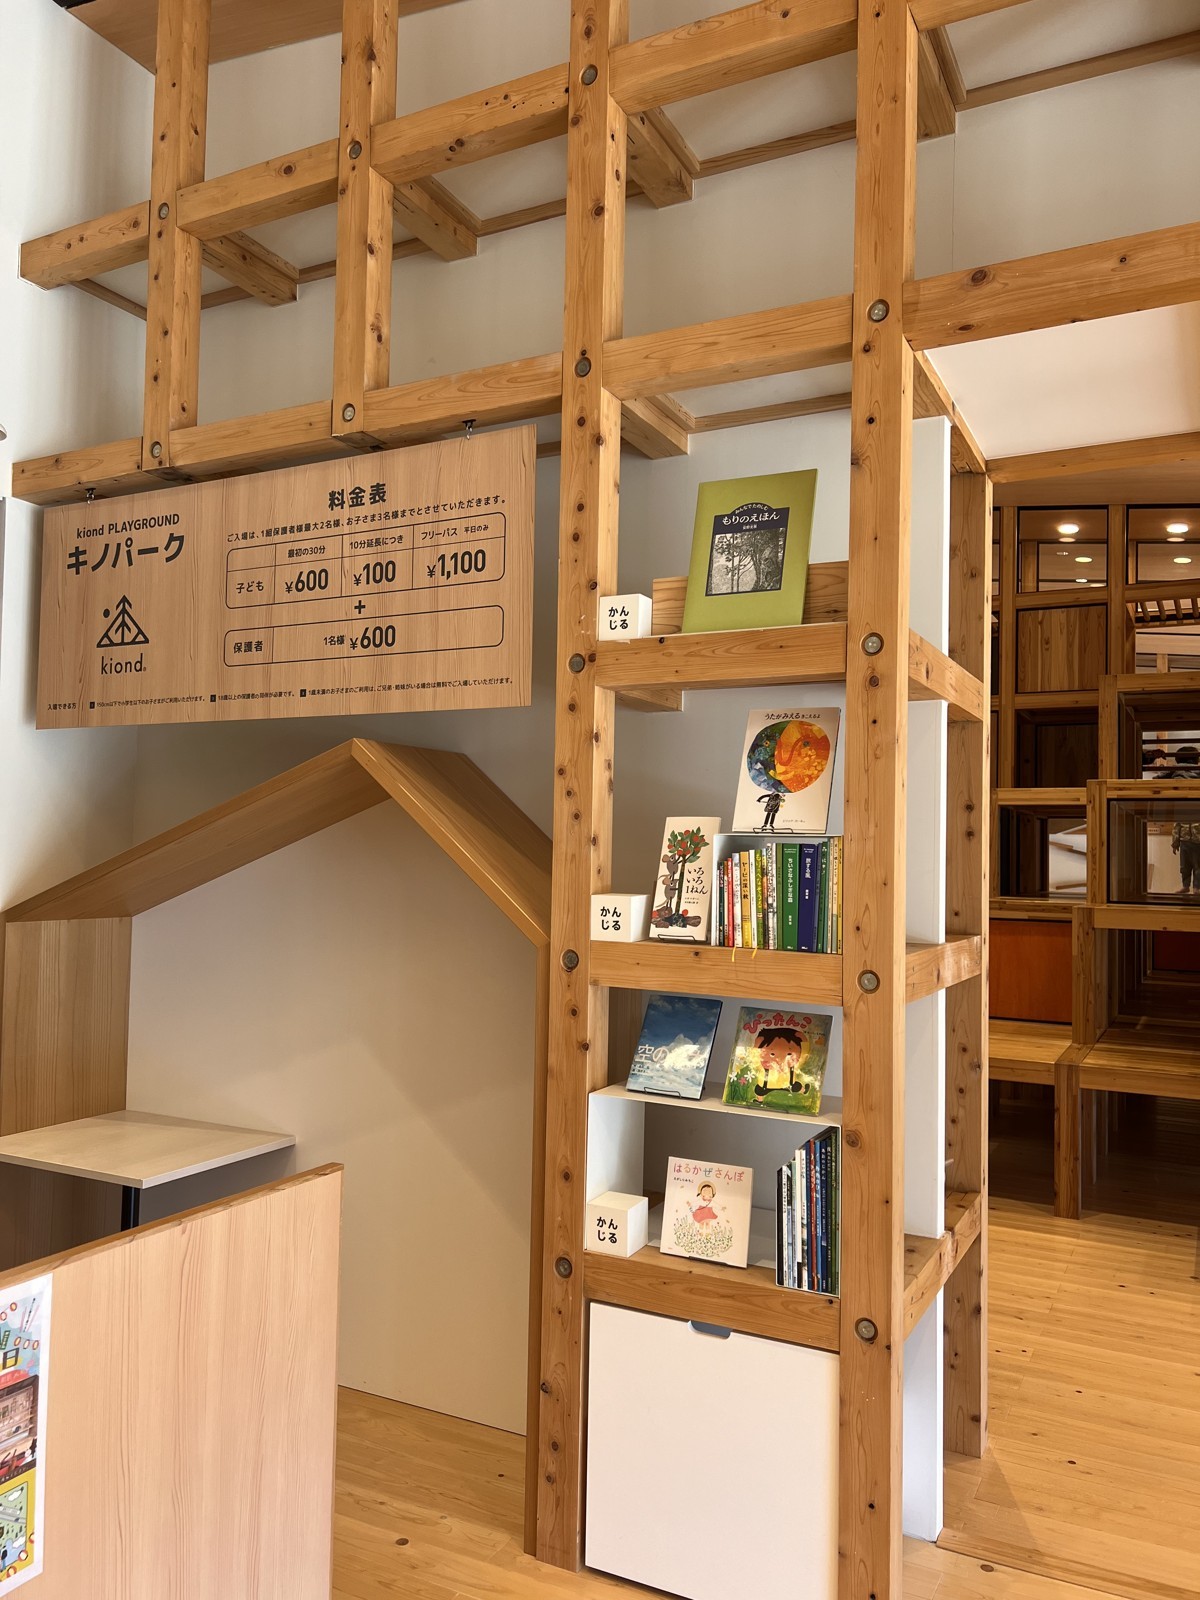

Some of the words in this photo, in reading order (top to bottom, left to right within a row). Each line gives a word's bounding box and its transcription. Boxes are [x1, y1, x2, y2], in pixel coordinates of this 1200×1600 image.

[328, 483, 386, 511] 料金表
[722, 511, 781, 525] もりのえほん
[76, 524, 104, 539] kiond
[108, 513, 180, 534] PLAYGROUND
[421, 527, 458, 541] フリーパス
[464, 524, 489, 534] 平日のみ
[350, 534, 404, 549] 10分延長につき
[67, 533, 185, 575] キノパーク
[288, 545, 326, 558] 最初の30分
[427, 549, 486, 580] ¥1,100
[353, 560, 396, 586] ¥100
[236, 580, 264, 594] 子ども
[285, 568, 329, 594] ¥600
[608, 606, 630, 618] かん
[609, 618, 629, 631] じる
[323, 635, 346, 646] 1名様
[350, 624, 396, 650] ¥600
[233, 640, 264, 654] 保護者
[687, 866, 705, 876] いろ
[686, 876, 704, 885] いろ
[685, 885, 708, 895] 1ねん
[600, 906, 622, 918] かん
[601, 919, 621, 931] じる
[673, 1163, 745, 1182] はるかぜさんぽ
[596, 1216, 618, 1230] かん
[597, 1229, 617, 1243] じる
